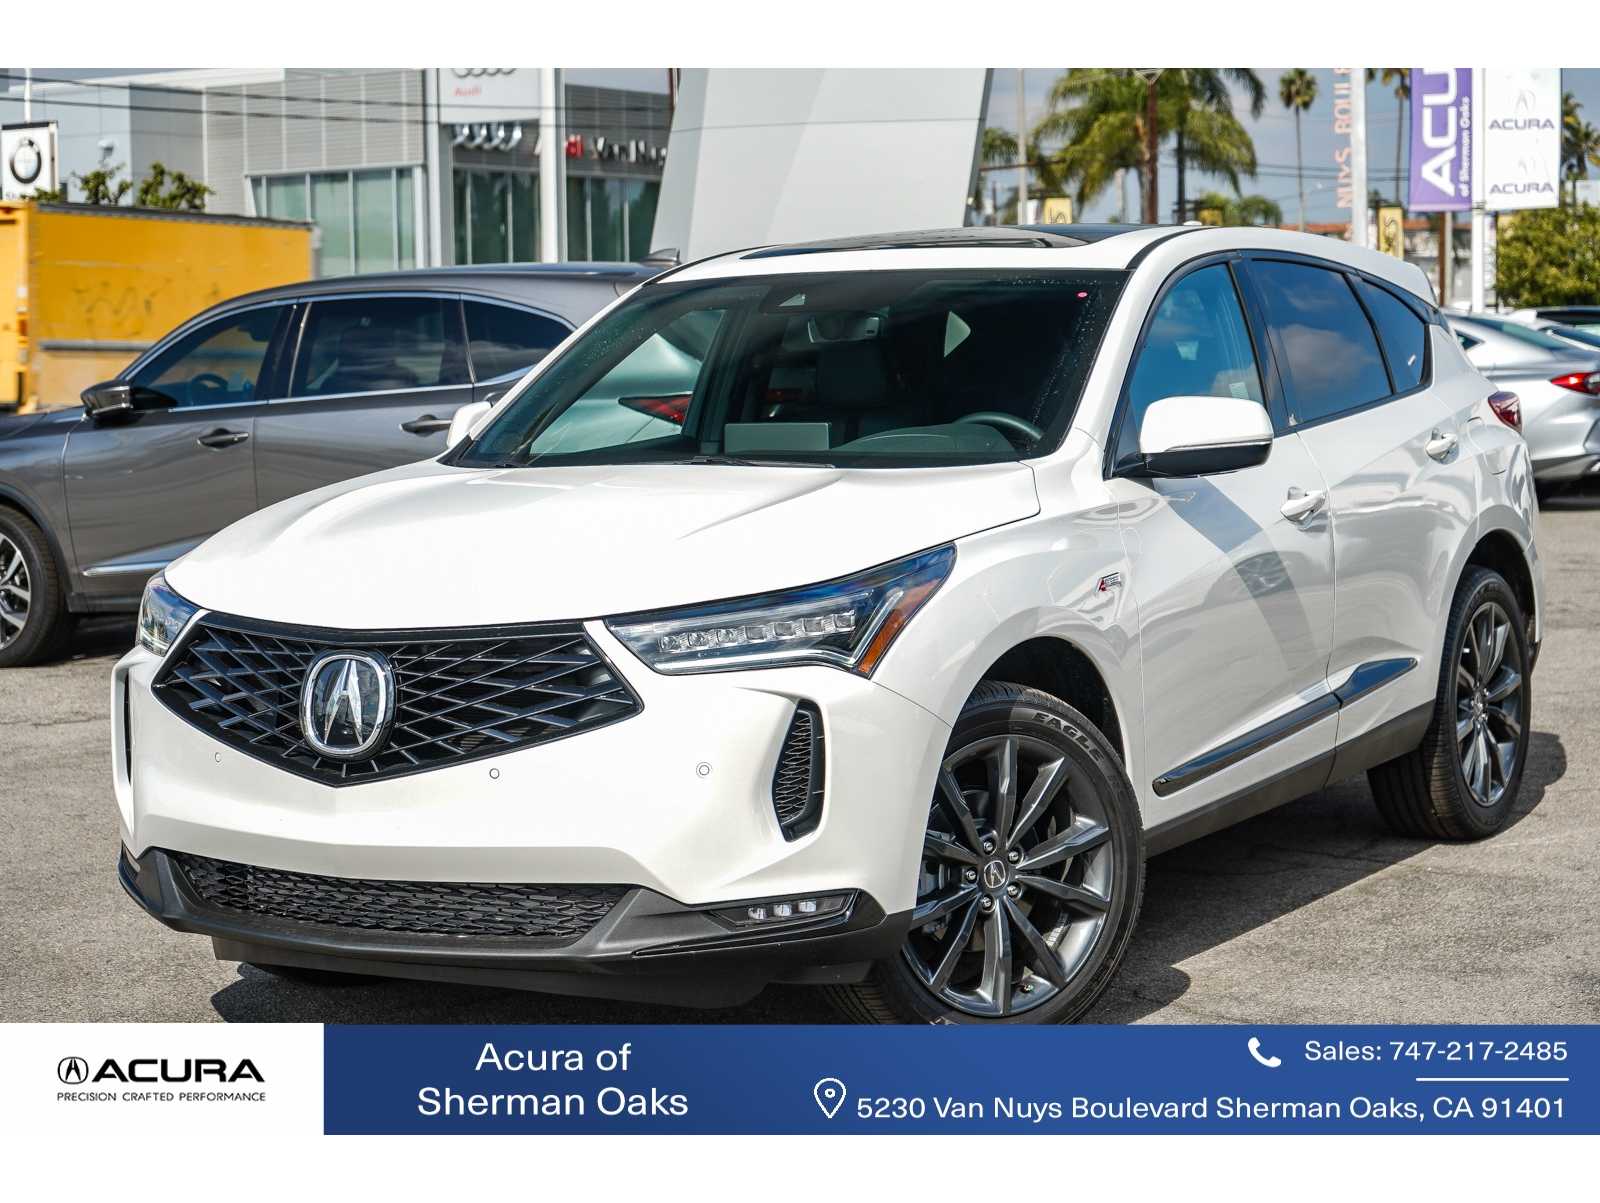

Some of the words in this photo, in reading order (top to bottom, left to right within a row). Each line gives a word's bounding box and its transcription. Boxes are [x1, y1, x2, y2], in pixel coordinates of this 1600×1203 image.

[453, 86, 482, 97] Audi
[1488, 118, 1555, 131] ACURA
[1421, 68, 1457, 197] ACU
[1489, 182, 1554, 195] ACURA
[1032, 712, 1105, 763] EAGLE
